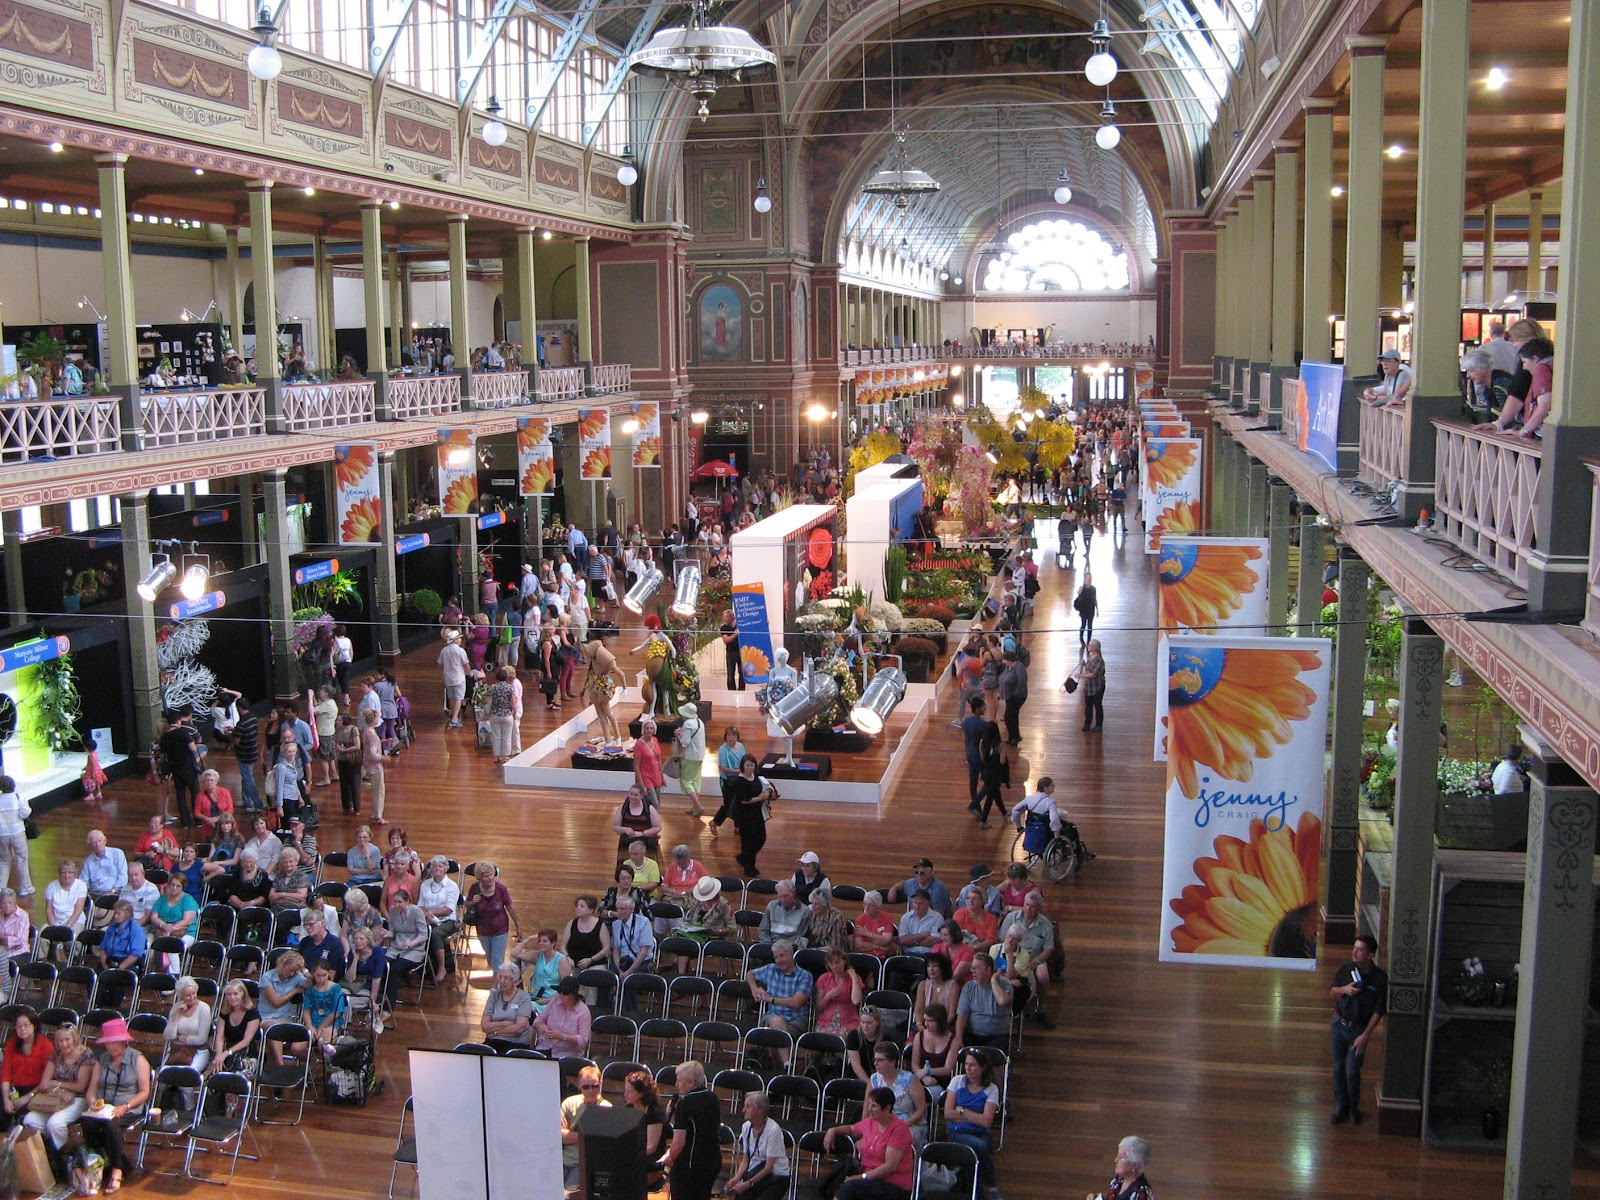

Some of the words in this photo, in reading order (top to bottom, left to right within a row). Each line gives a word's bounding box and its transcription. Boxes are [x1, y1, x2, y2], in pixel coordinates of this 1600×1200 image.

[525, 448, 547, 462] jenny
[446, 464, 471, 480] jenny
[345, 485, 372, 502] jenny
[1156, 486, 1191, 506] jenny
[24, 654, 42, 663] College
[1195, 777, 1298, 832] jenny
[1217, 810, 1258, 819] CRAIG
